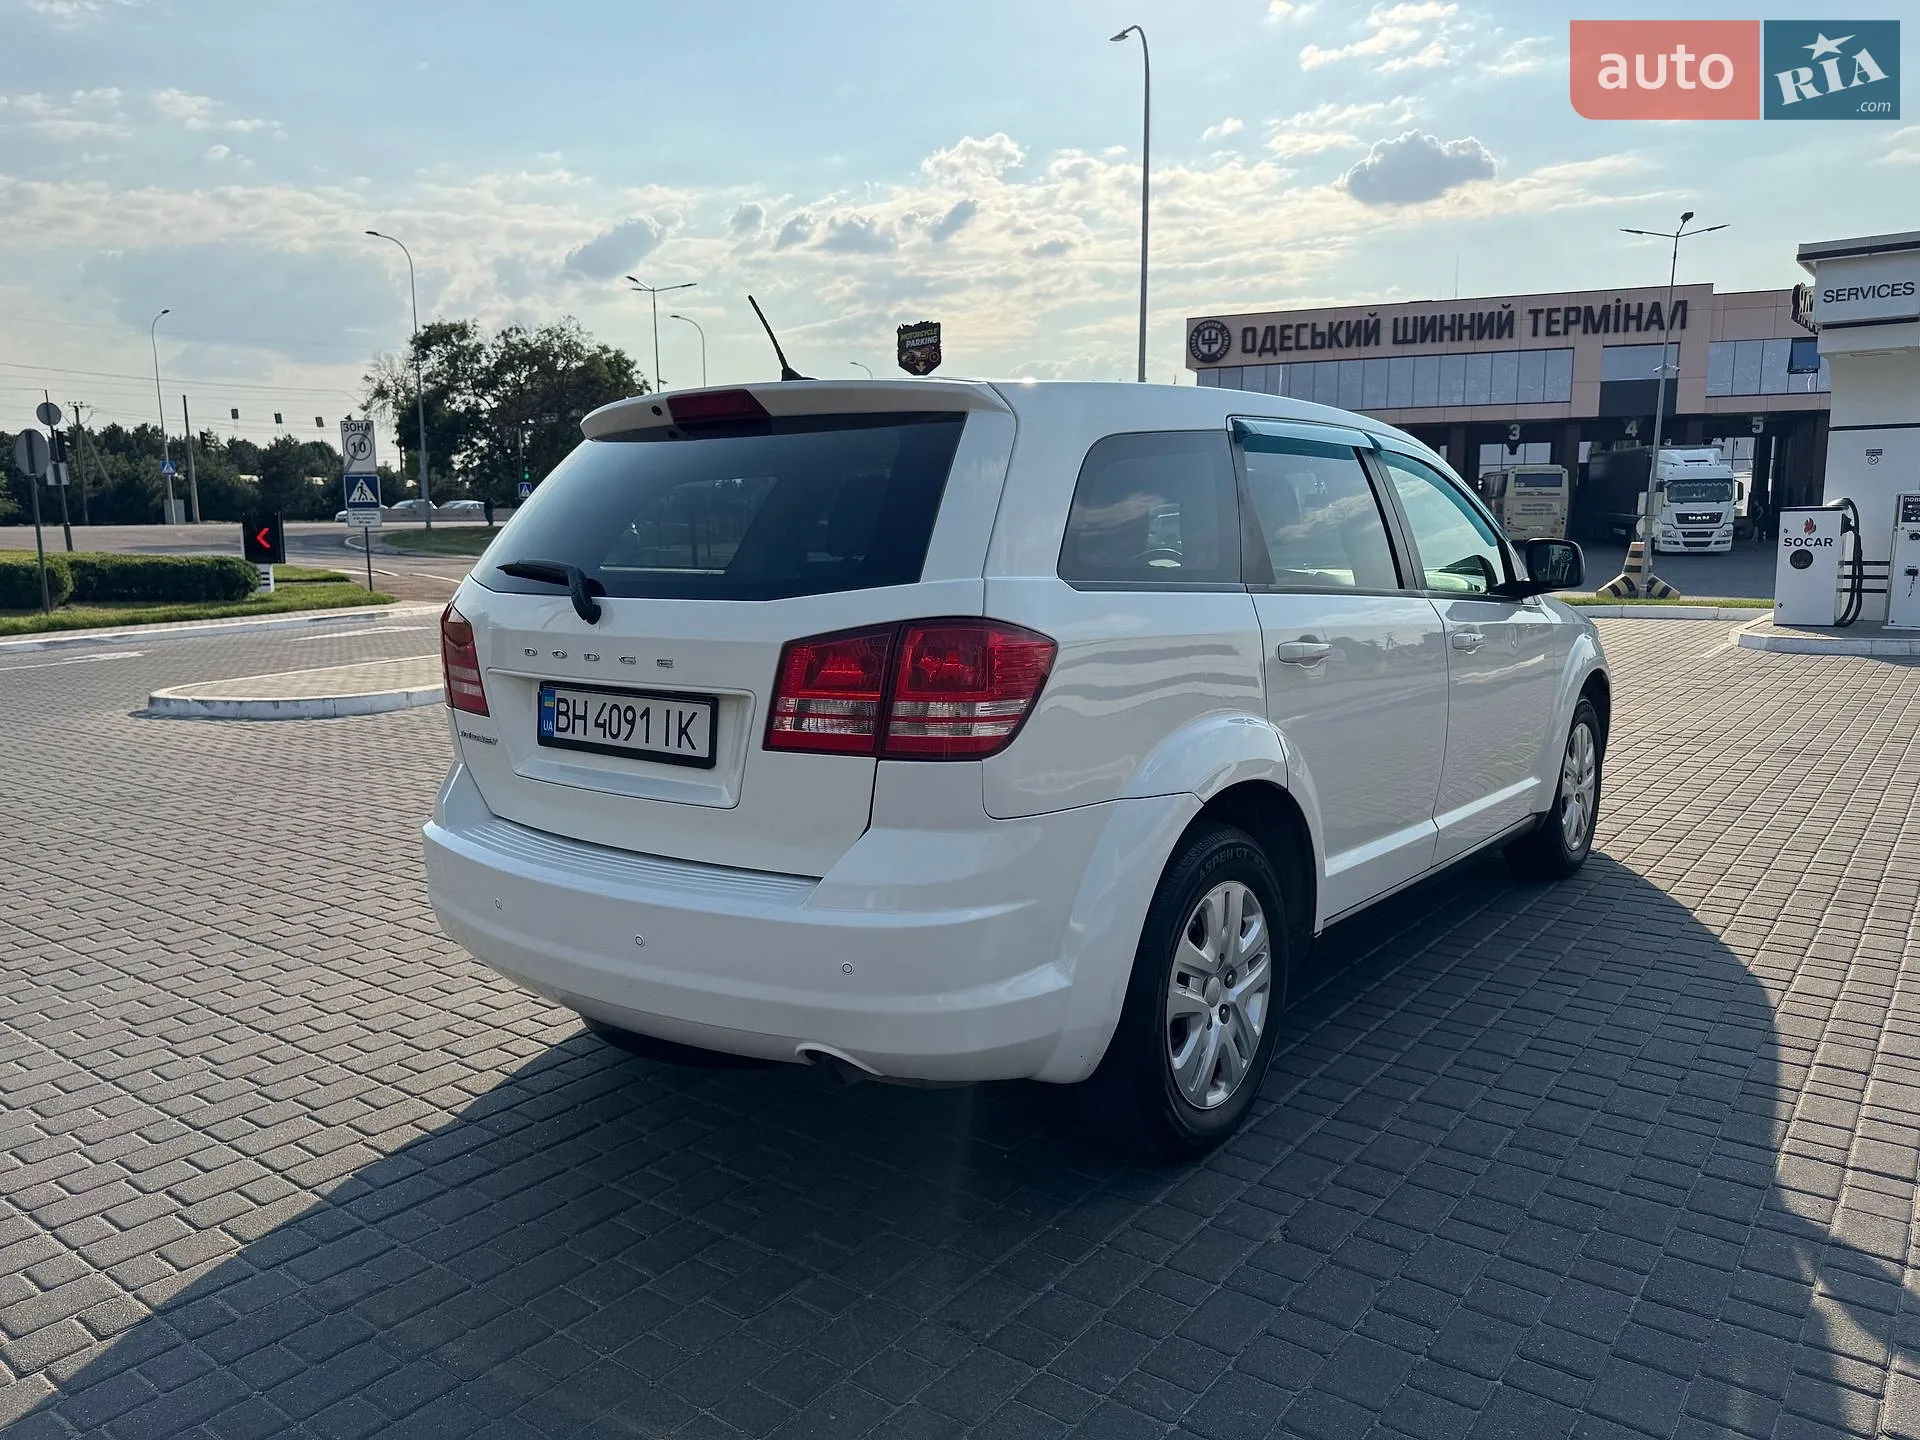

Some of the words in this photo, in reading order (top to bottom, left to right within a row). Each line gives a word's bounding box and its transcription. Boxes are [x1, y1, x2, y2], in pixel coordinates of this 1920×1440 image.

[1822, 281, 1915, 303] SERVICES
[1241, 311, 1381, 357] ОДЕСЬКИЙ
[1392, 304, 1515, 345] ШИННИЙ
[905, 335, 938, 348] PARKING
[343, 422, 372, 433] ЗОНА
[1509, 424, 1520, 440] 3
[1625, 420, 1638, 437] 4
[1752, 415, 1763, 433] 5
[351, 441, 367, 453] 10
[1783, 537, 1833, 547] SOCAR
[524, 647, 674, 668] DODGE
[543, 721, 553, 732] UA
[555, 697, 588, 736] BH
[594, 702, 651, 744] 4091
[664, 709, 698, 750] IK
